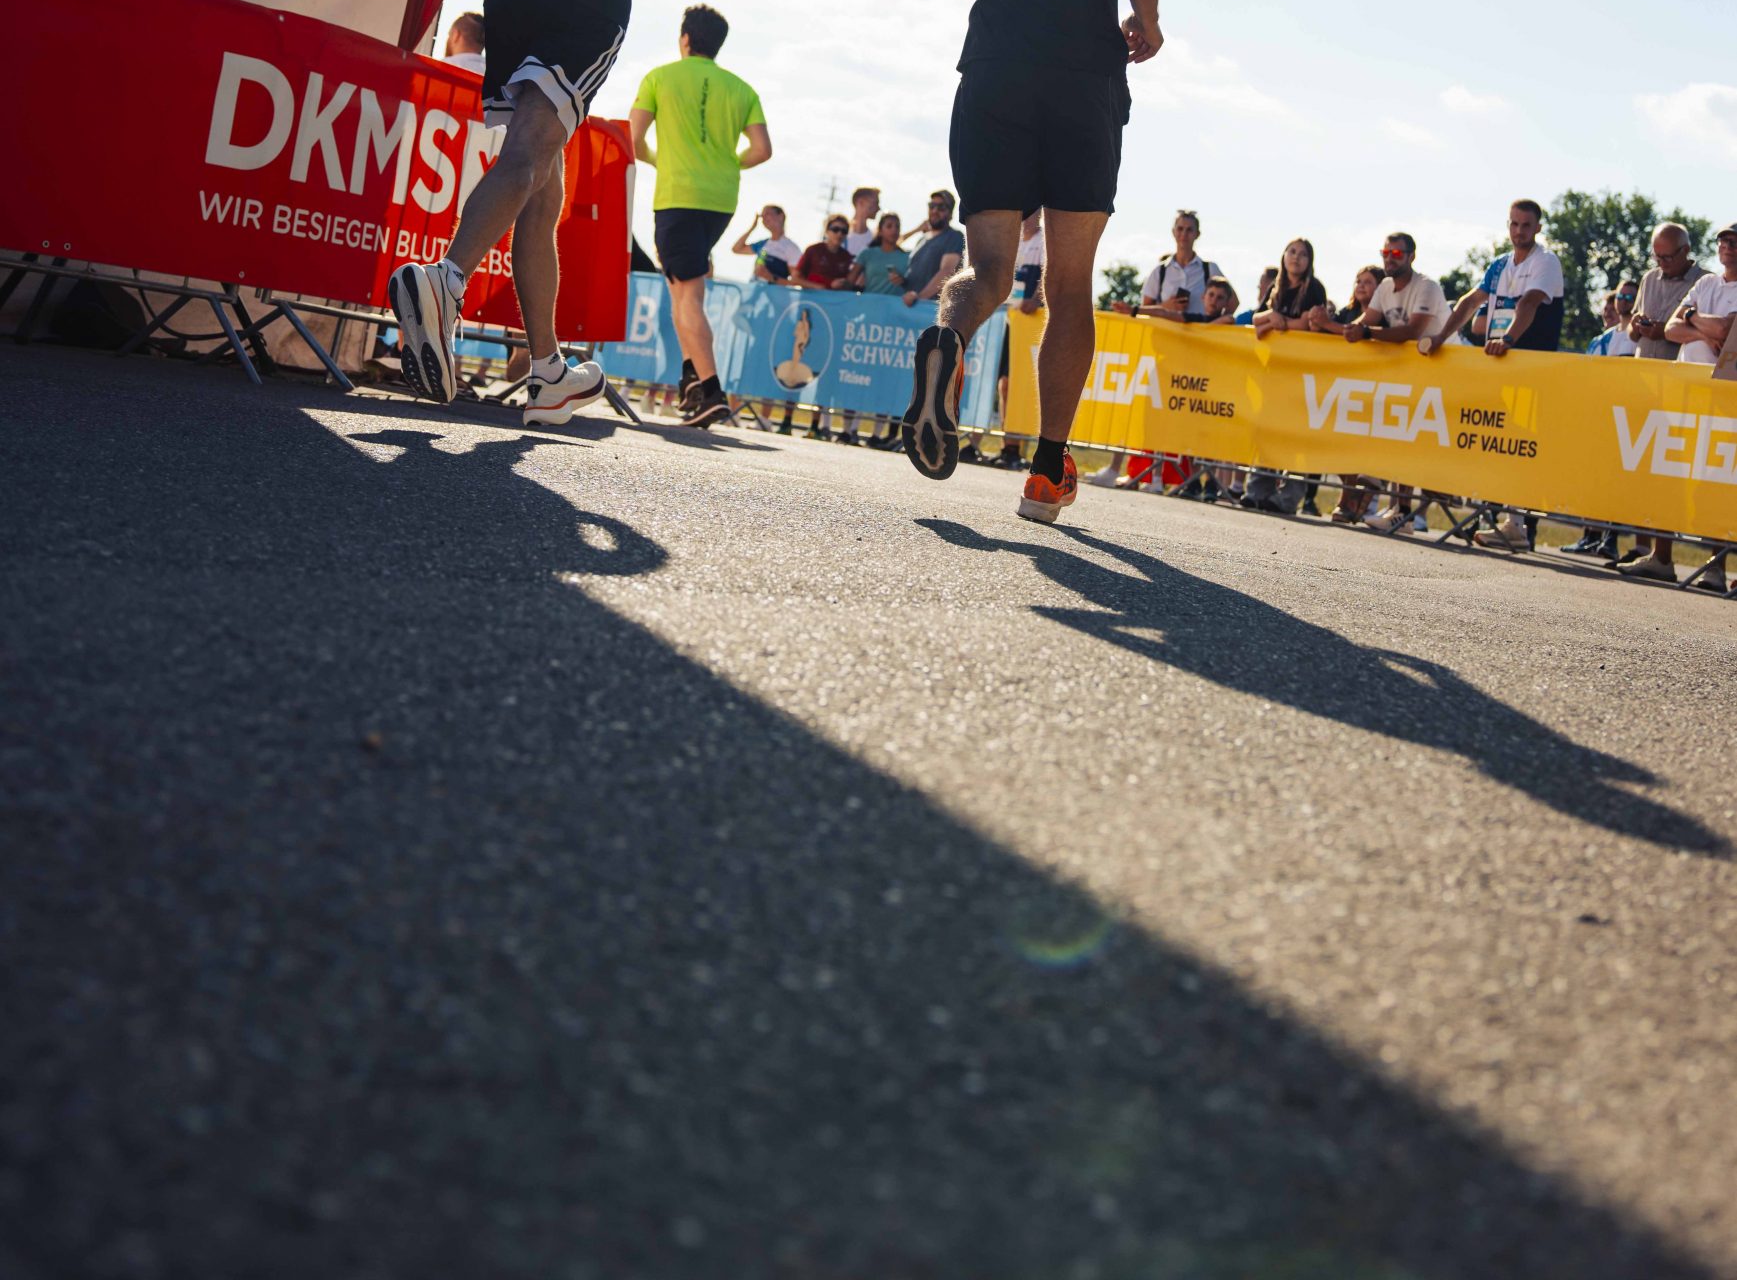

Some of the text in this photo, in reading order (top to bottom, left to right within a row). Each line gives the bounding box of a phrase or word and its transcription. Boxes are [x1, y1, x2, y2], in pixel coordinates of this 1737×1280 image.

[205, 51, 461, 214] DKMS
[199, 190, 264, 231] WIR
[272, 203, 390, 254] BESIEGEN
[1171, 374, 1210, 393] HOME
[1168, 394, 1235, 419] OF VALUES
[1302, 373, 1450, 448] VEGA
[1460, 407, 1507, 429] HOME
[1457, 431, 1538, 459] OF VALUES
